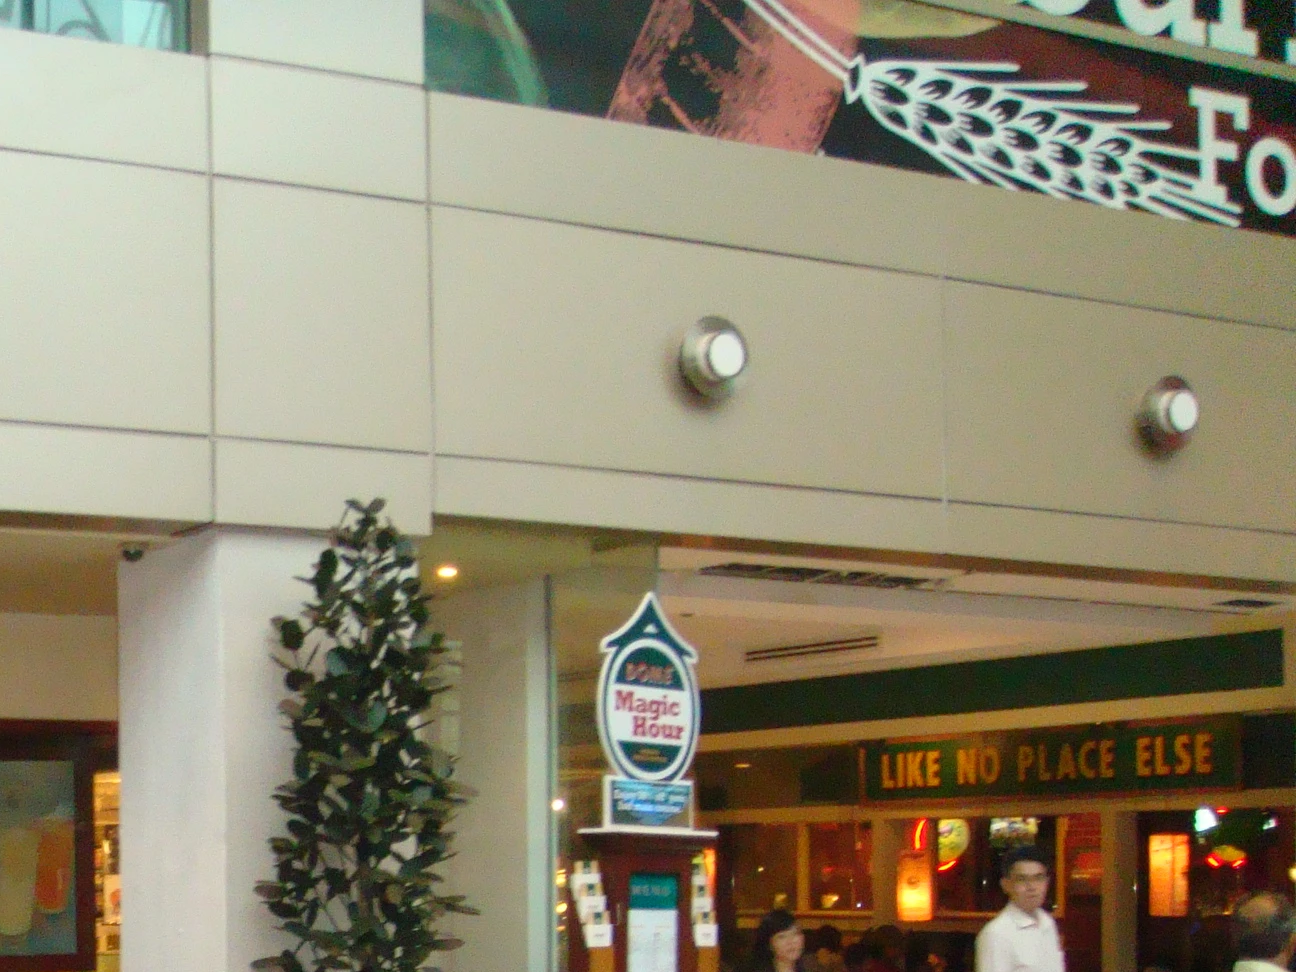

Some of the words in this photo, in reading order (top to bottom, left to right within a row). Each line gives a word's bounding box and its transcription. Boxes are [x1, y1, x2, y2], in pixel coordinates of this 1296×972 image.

[614, 689, 681, 721] Magic
[632, 715, 685, 741] Hour
[880, 750, 942, 789] LIKE
[956, 746, 1001, 785] NO
[1017, 739, 1116, 783] PLACE
[1135, 732, 1213, 777] ELSE
